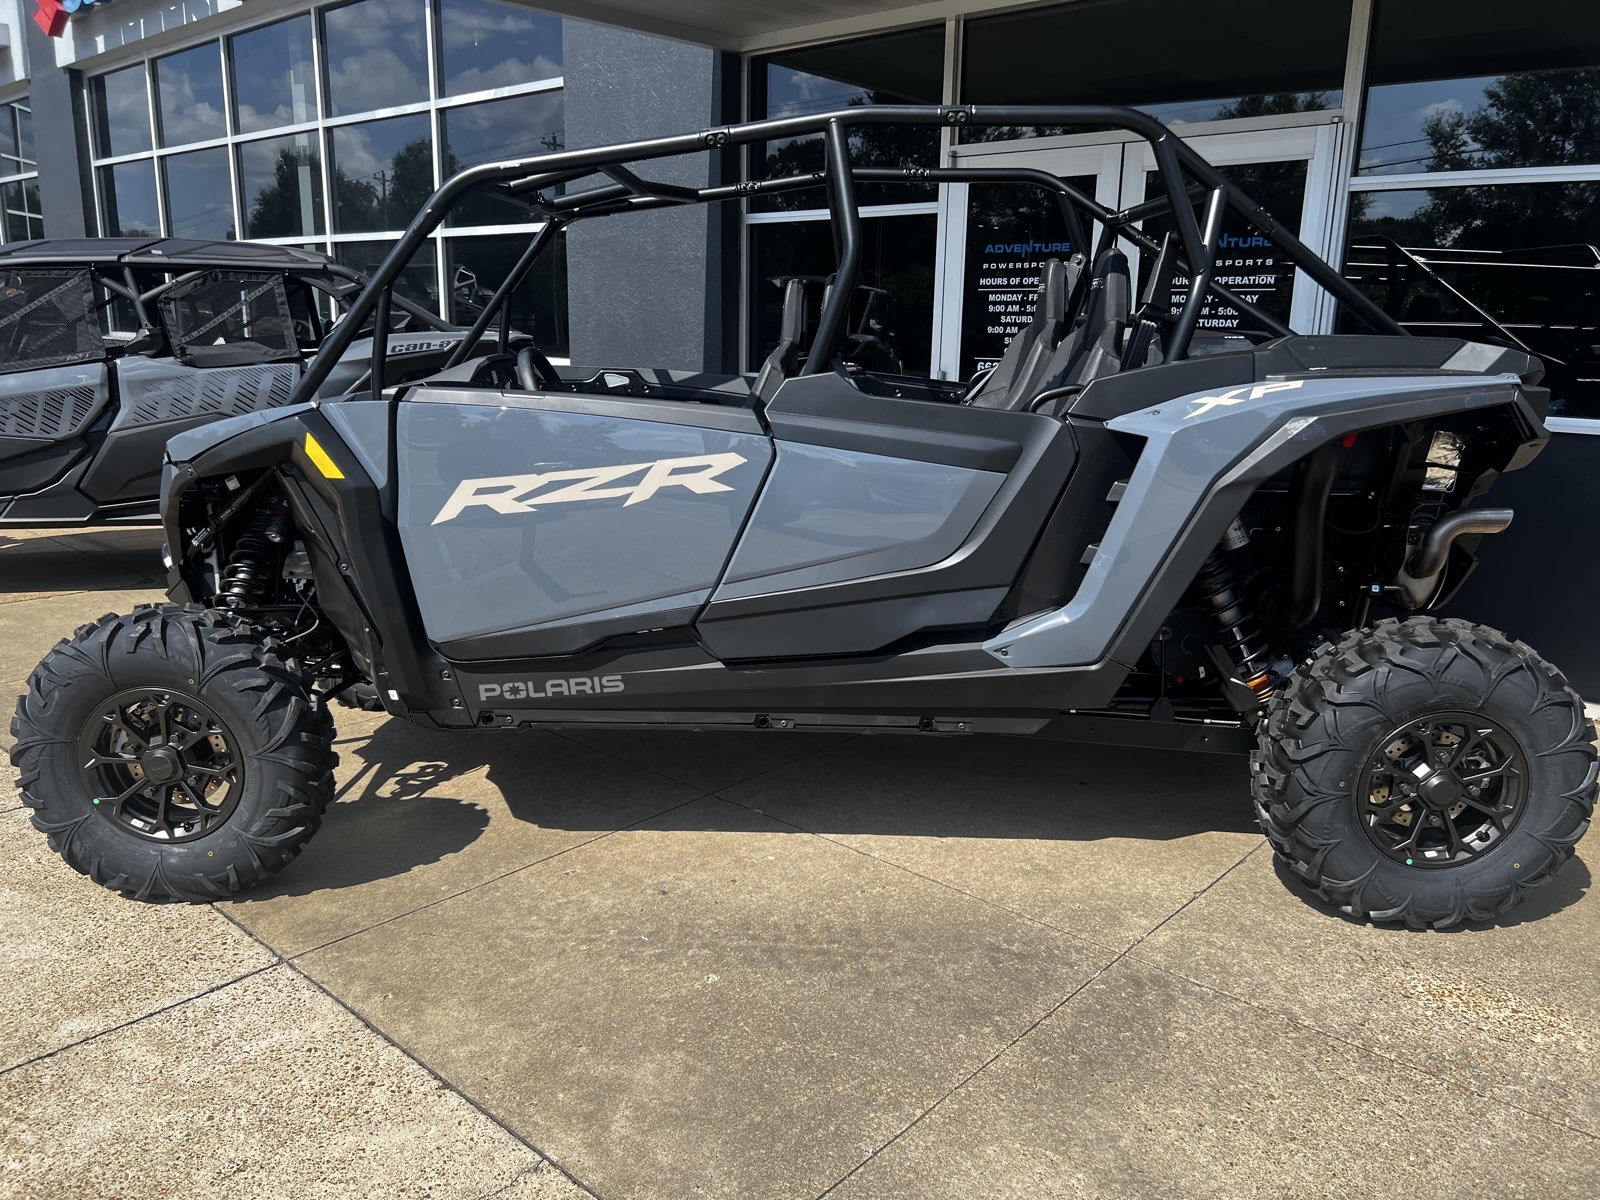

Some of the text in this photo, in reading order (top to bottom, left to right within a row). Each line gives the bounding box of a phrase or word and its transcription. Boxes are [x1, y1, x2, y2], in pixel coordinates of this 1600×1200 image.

[984, 239, 1071, 258] ADVENTURE
[982, 261, 1069, 269] POWERSPOS
[979, 277, 1008, 286] HOURS
[1009, 277, 1021, 285] OF
[988, 294, 1023, 302] MONDAY
[988, 304, 1005, 312] 9:00
[1006, 304, 1020, 312] AM
[1000, 315, 1033, 323] SATURD
[1196, 319, 1240, 328] TURDAY
[987, 326, 1018, 334] 9:00 AM
[390, 340, 452, 353] can-a
[1182, 380, 1304, 420] XP
[430, 452, 748, 526] RZR
[478, 674, 625, 701] POLARIS
